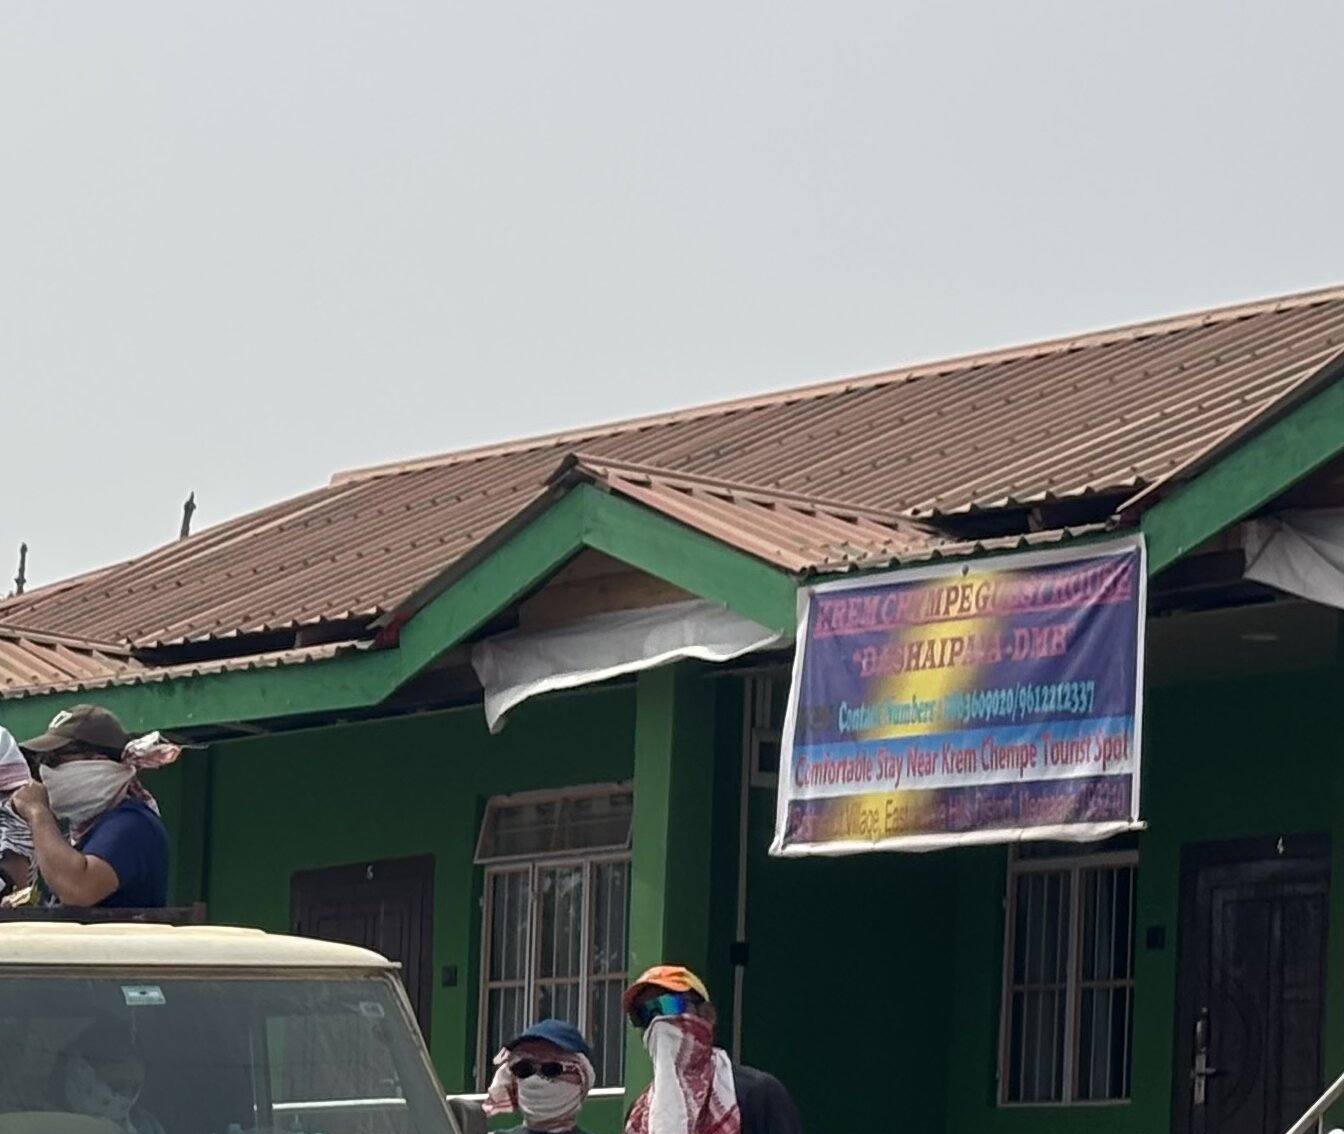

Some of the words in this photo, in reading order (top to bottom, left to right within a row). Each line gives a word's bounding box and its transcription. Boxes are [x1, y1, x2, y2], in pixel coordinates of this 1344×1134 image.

[795, 750, 872, 787] Comfortable
[876, 748, 903, 788] Stay
[907, 748, 937, 777] Near
[942, 742, 976, 774] Krem
[981, 735, 1037, 778] Chempe
[1041, 730, 1091, 765] Tourist
[1094, 727, 1129, 771] Spot
